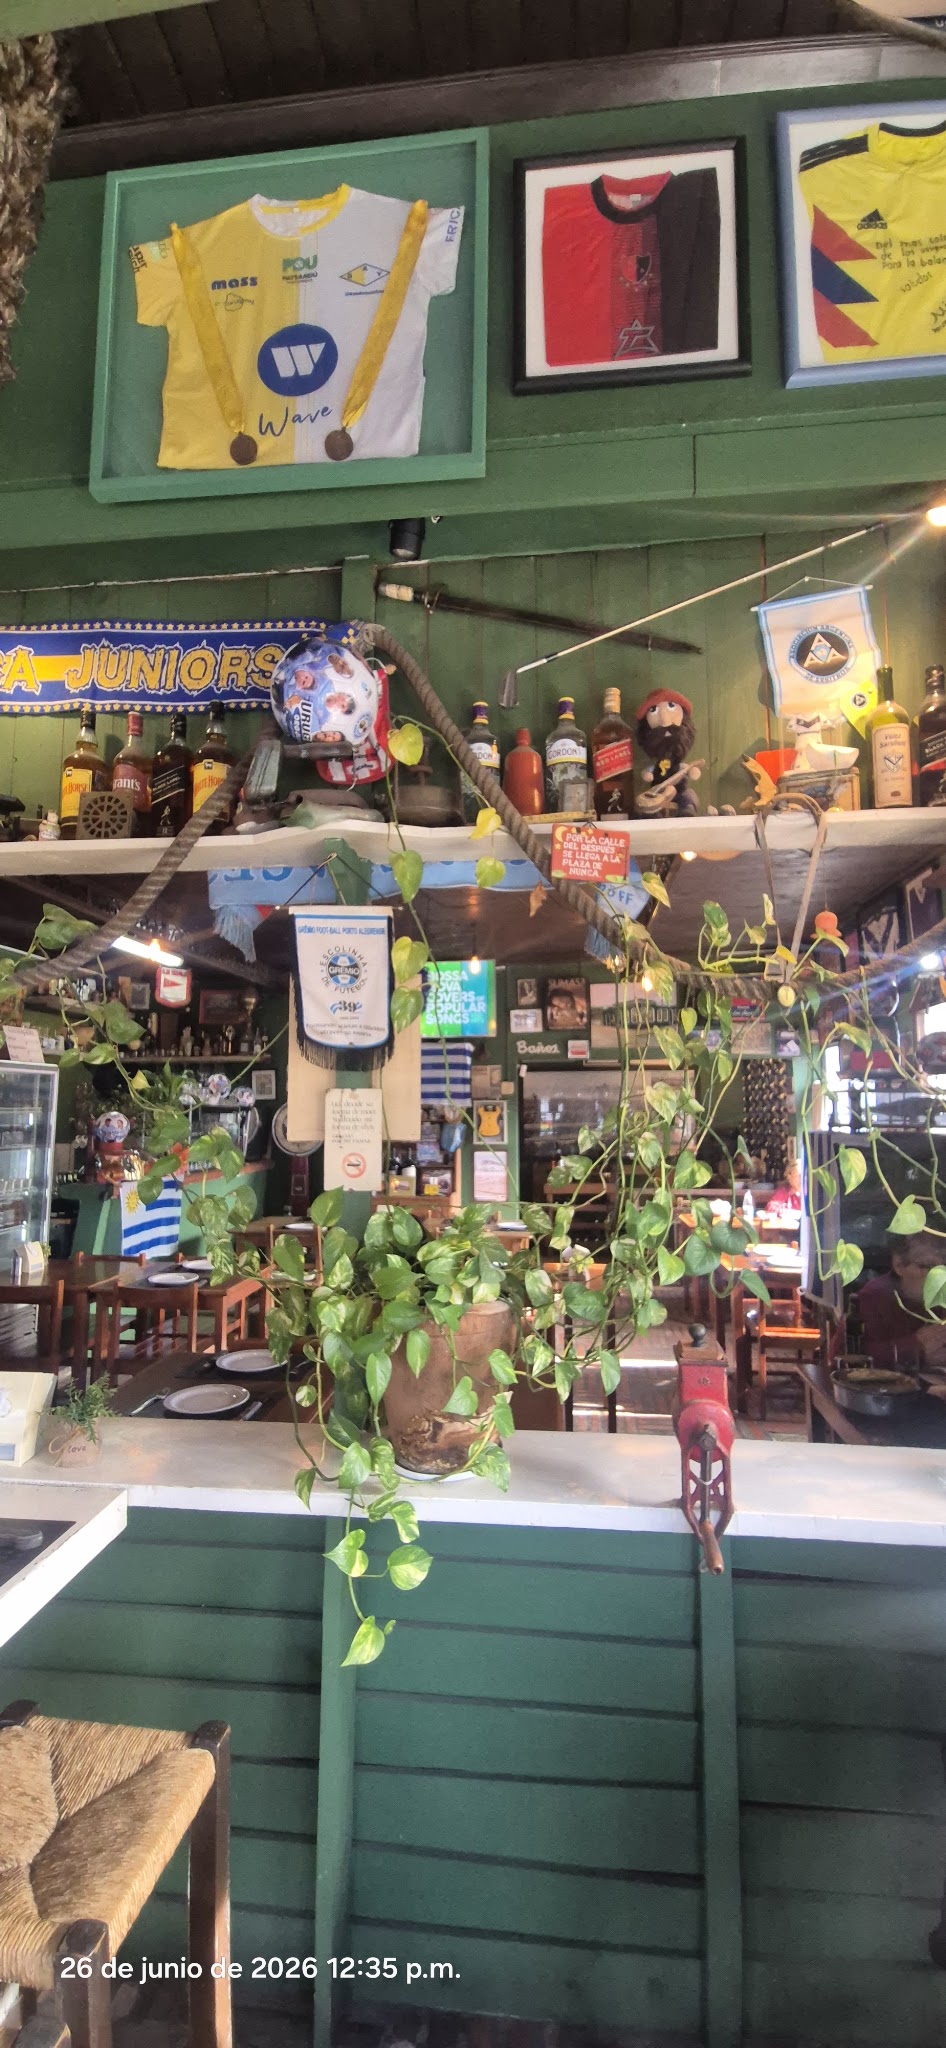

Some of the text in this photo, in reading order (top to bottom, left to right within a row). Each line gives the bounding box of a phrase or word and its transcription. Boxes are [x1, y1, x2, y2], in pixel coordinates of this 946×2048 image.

[857, 221, 888, 230] adidas
[259, 406, 333, 437] Wave
[0, 640, 285, 695] A JUNIORS
[113, 778, 141, 791] rant's
[563, 842, 578, 851] DEL
[566, 833, 626, 848] POR LA CALLE
[562, 850, 621, 864] SE LLEGA A LA
[562, 858, 603, 870] PLAZA DE
[320, 945, 368, 968] ESCOLINHA
[321, 976, 369, 994] DE FUTEBOL
[516, 1040, 560, 1054] Baños
